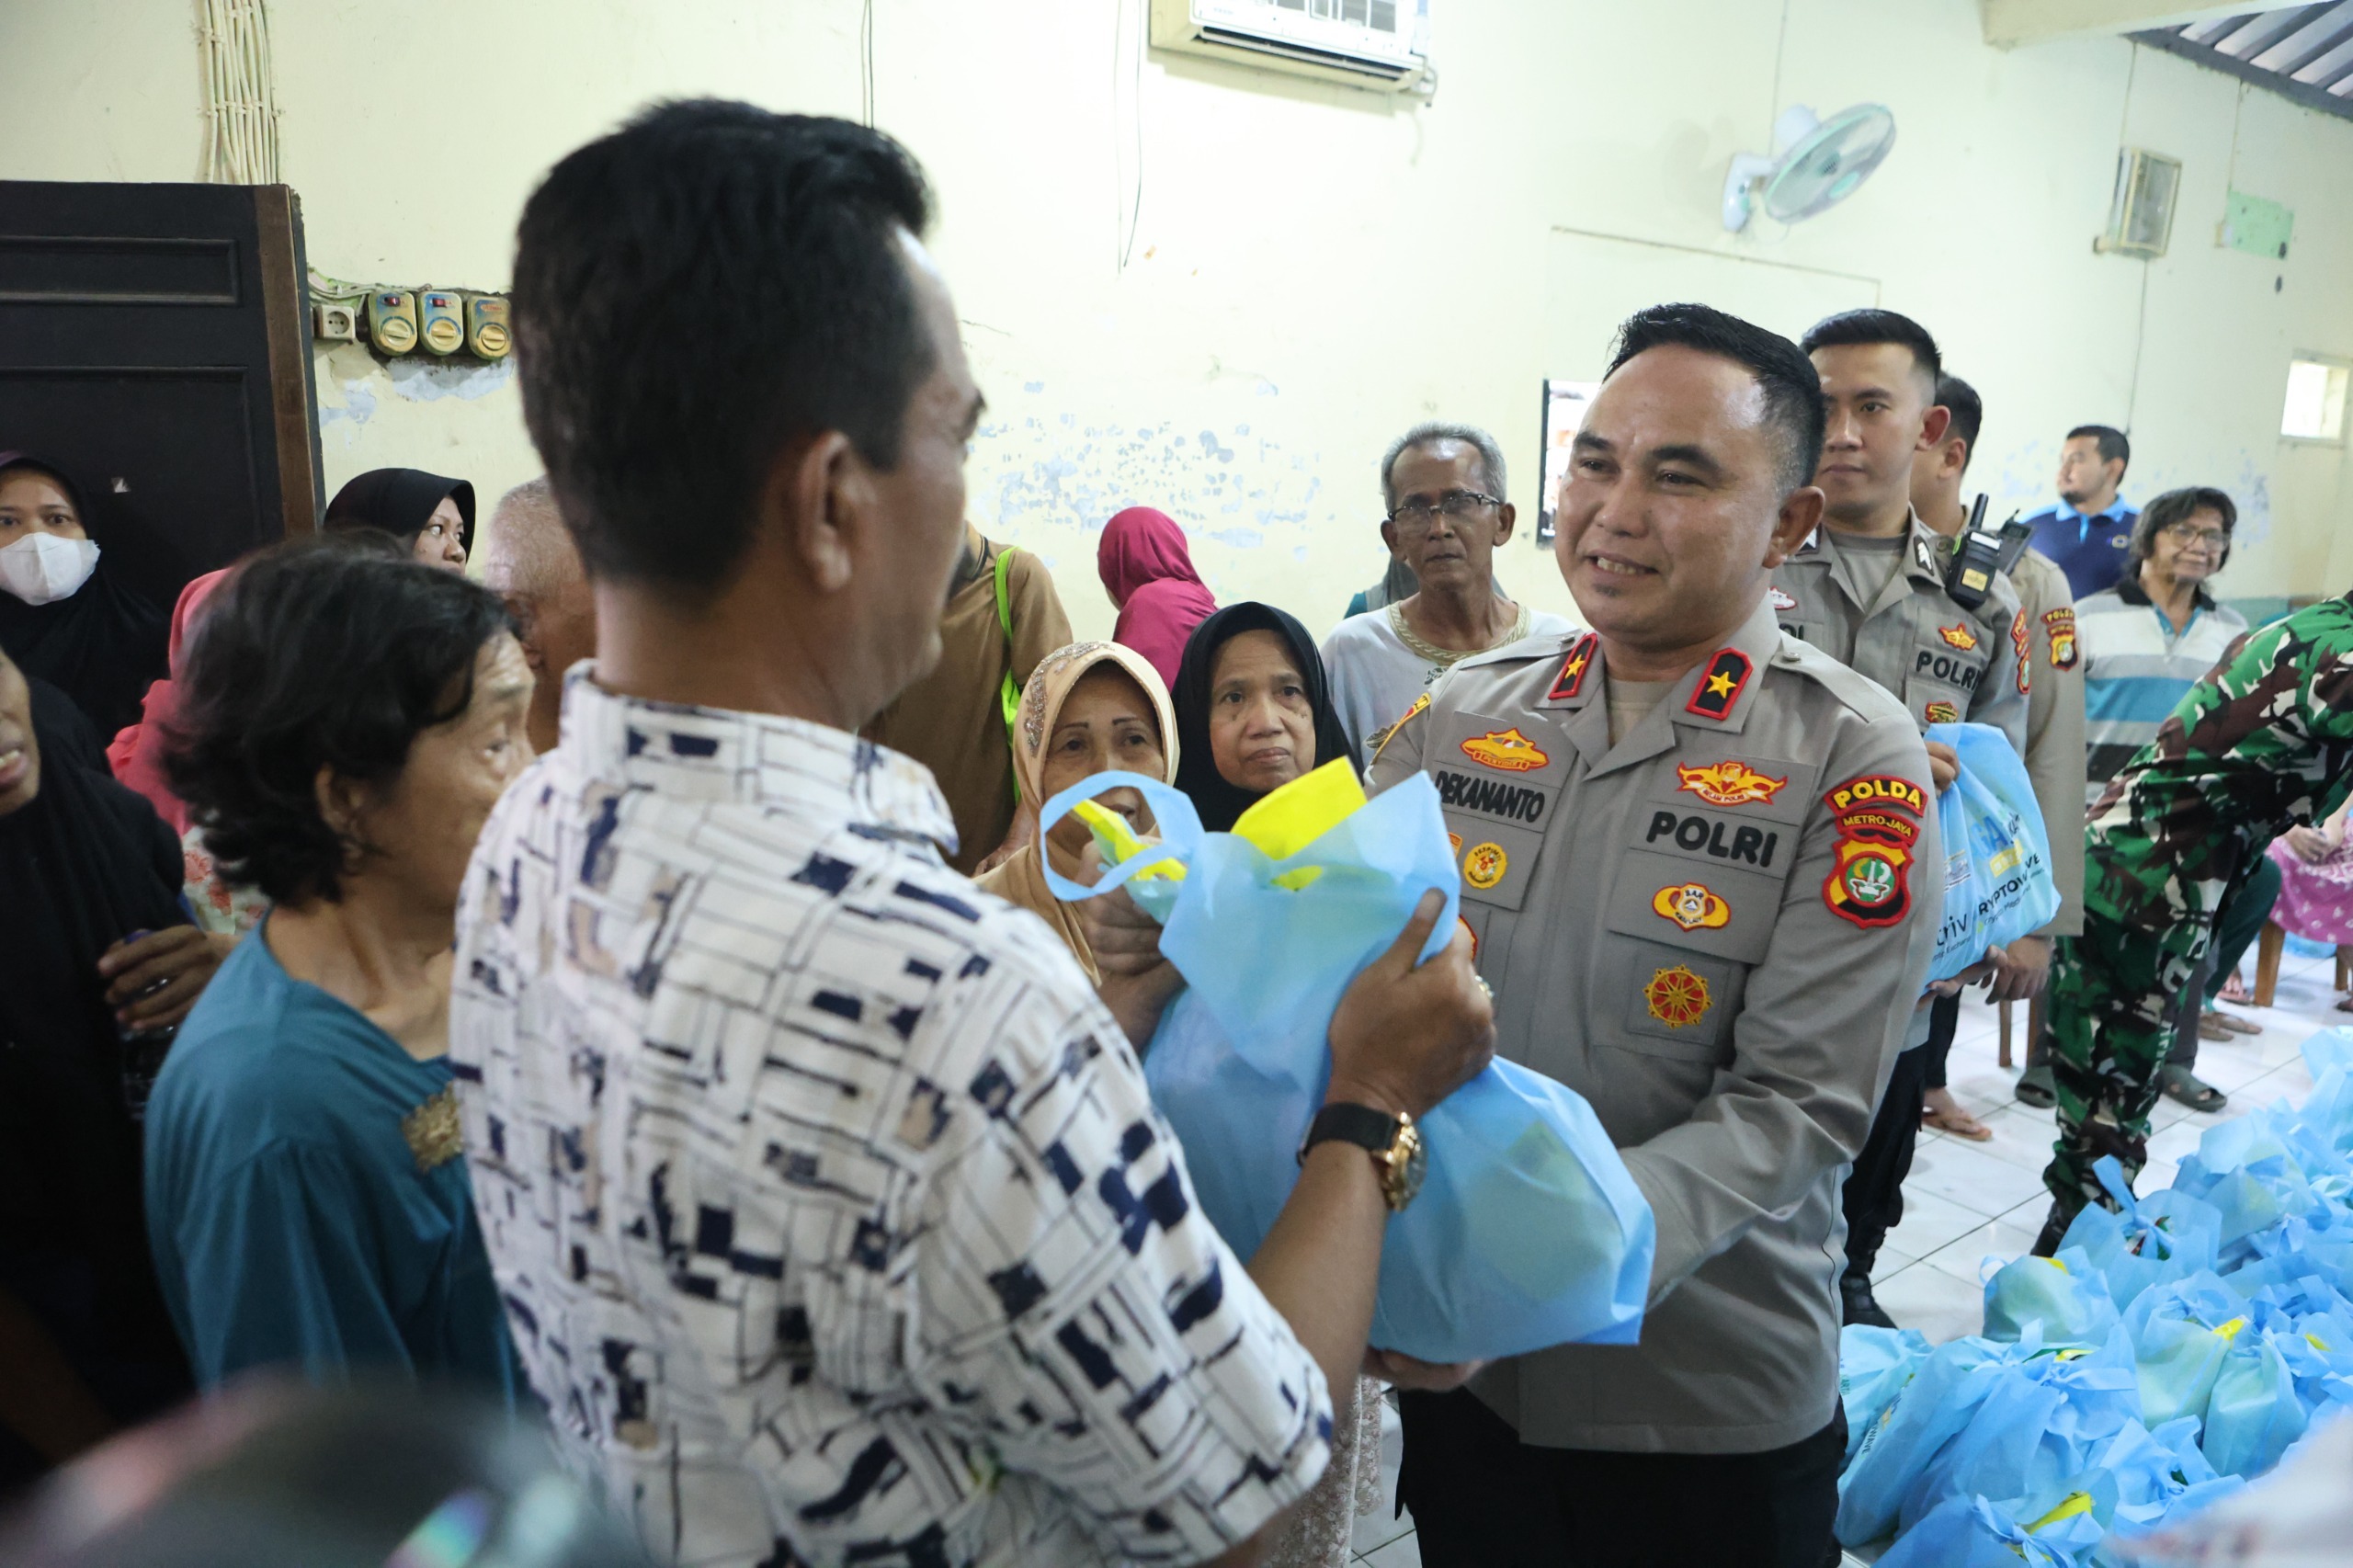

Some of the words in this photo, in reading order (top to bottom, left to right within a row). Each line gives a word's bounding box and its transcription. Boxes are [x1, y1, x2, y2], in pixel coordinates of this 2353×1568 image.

[1916, 651, 1981, 692] POLRI
[1435, 770, 1545, 823] DEKANANTO
[1833, 779, 1921, 810] POLDA
[1646, 811, 1778, 868] POLRI
